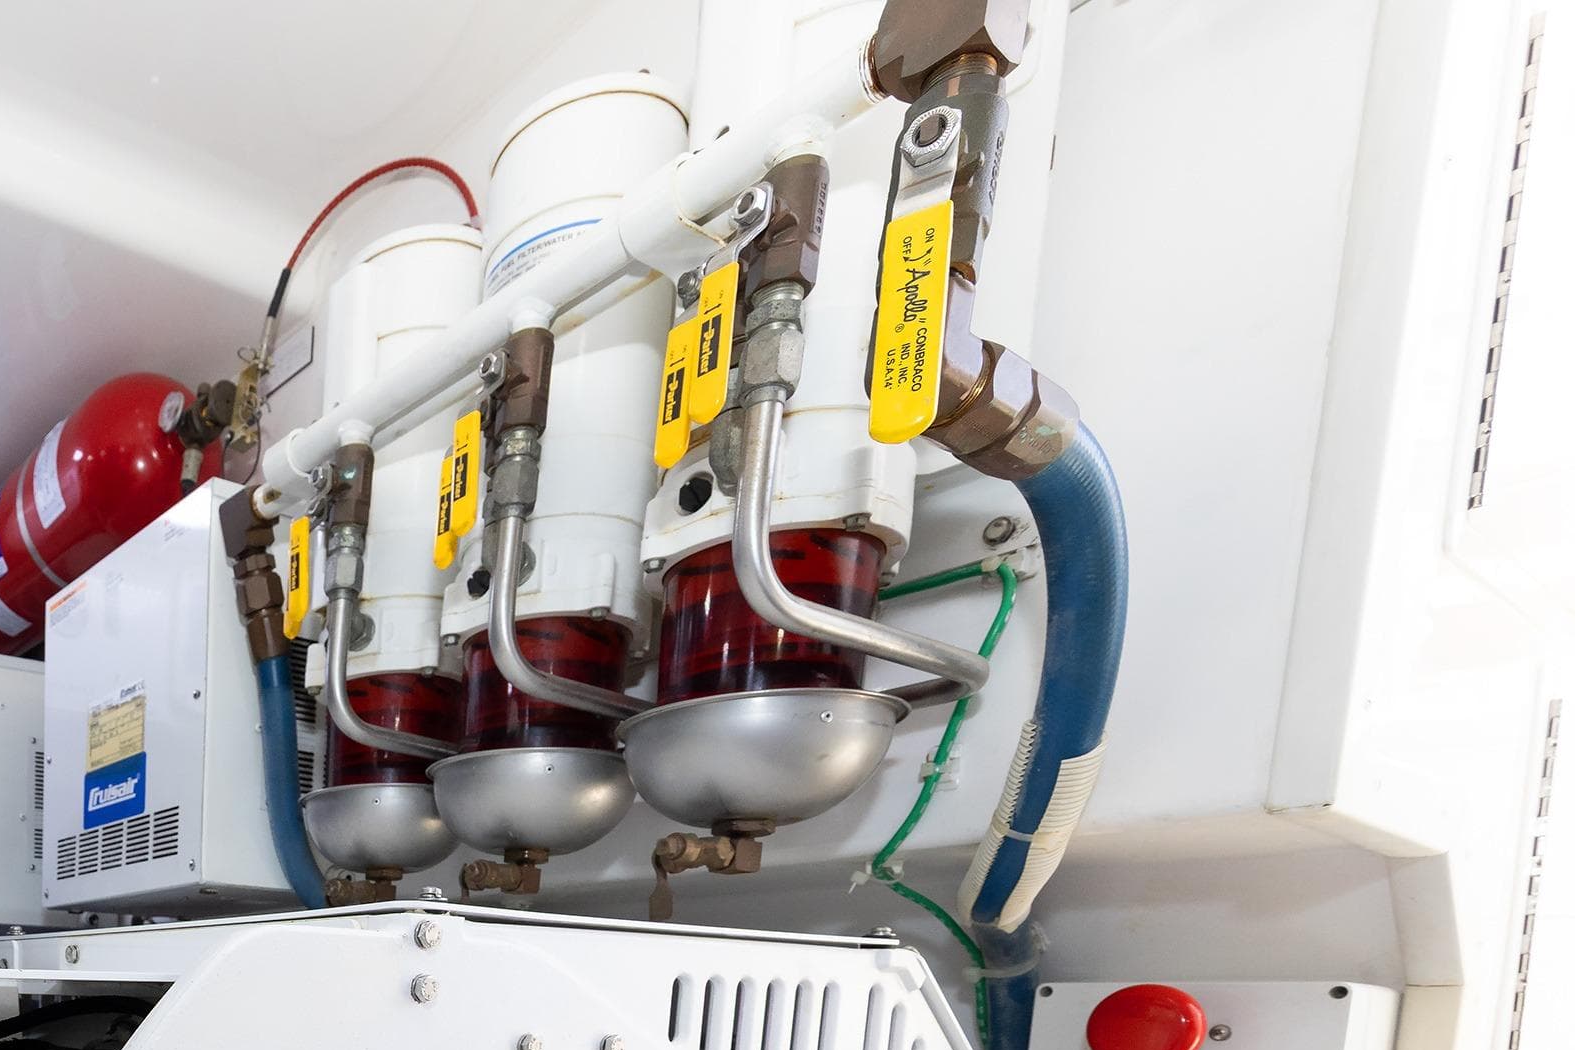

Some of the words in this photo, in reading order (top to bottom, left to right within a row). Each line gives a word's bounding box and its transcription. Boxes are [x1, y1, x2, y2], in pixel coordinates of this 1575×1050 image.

[903, 236, 912, 255] OFF
[924, 227, 935, 243] ON
[699, 316, 716, 375] Parker
[911, 328, 927, 392] CONBRACO
[664, 369, 679, 424] Parker
[454, 455, 465, 499] Parker
[88, 777, 138, 812] Cruisair
